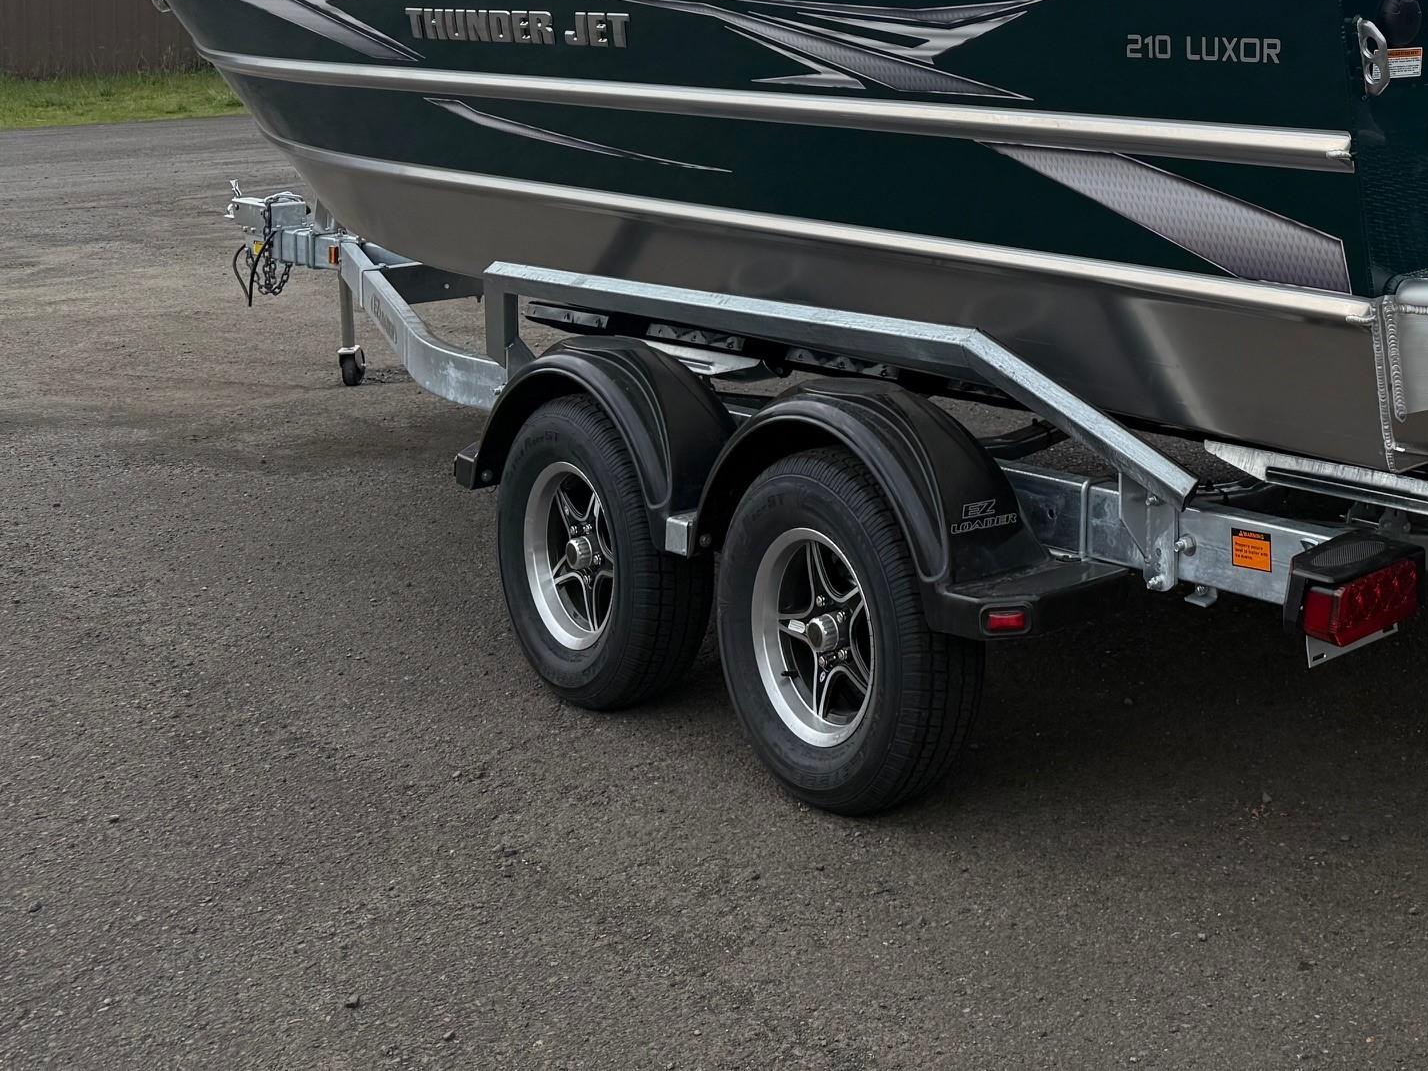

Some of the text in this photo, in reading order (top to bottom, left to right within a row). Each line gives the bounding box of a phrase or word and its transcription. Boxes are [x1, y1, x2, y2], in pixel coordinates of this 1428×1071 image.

[404, 7, 630, 48] THUNDER JET
[1126, 34, 1281, 64] 210 LUXOR
[962, 499, 996, 519] EZ
[950, 512, 1017, 534] LOADER
